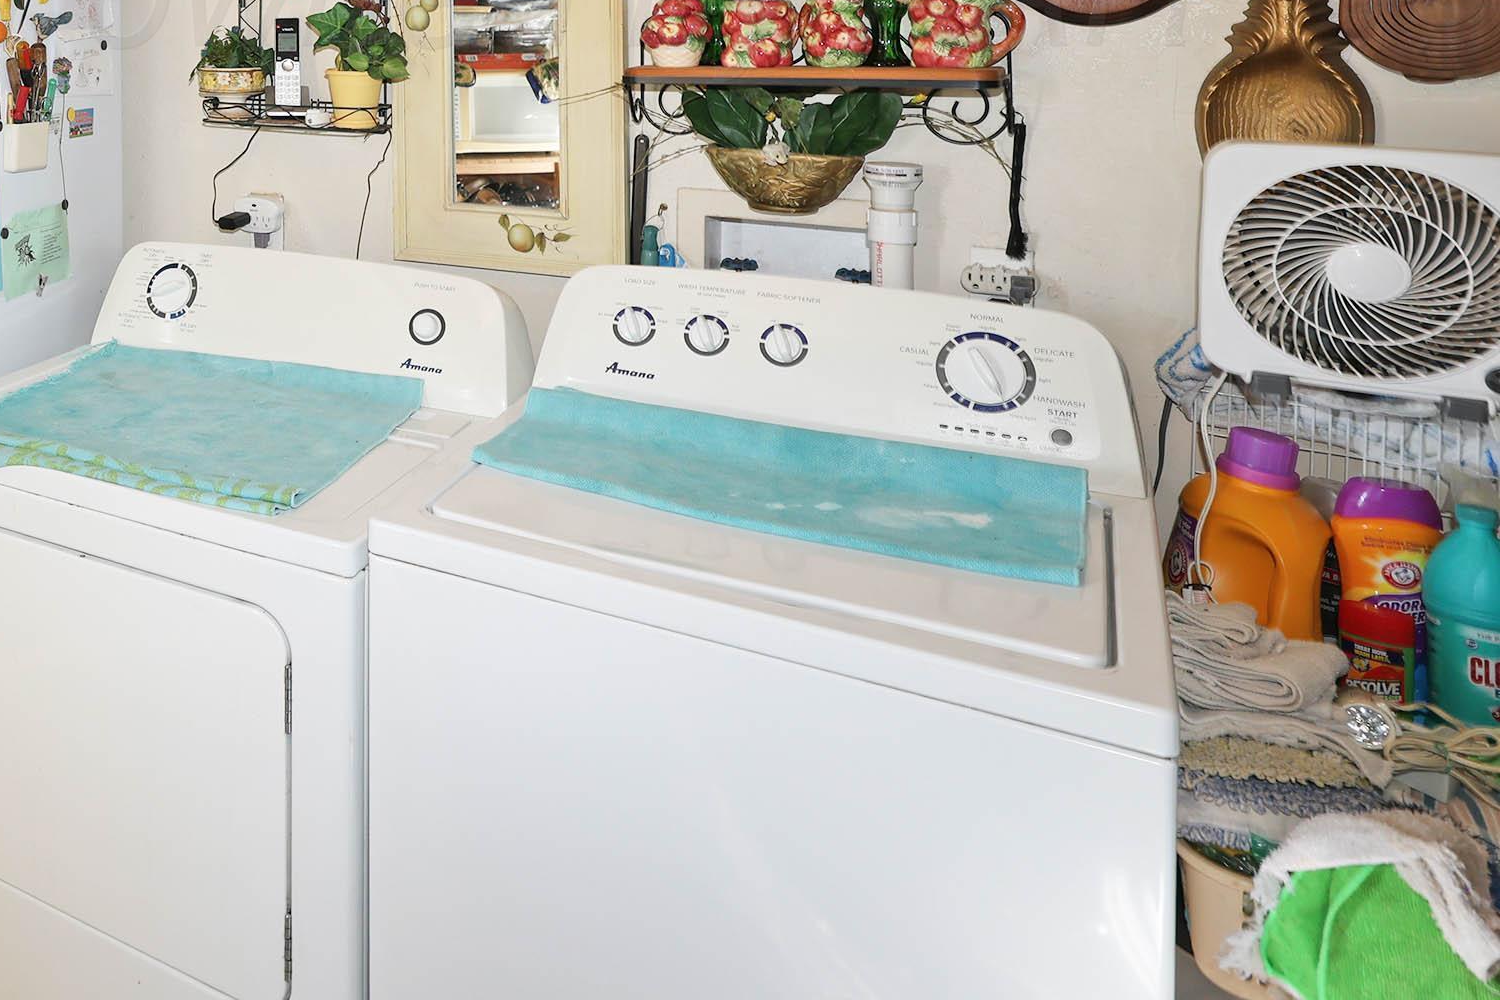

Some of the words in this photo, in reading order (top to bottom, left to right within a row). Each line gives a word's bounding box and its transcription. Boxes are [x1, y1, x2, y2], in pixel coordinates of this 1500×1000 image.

[624, 277, 642, 285] LOAD
[677, 283, 698, 291] WASH
[699, 285, 747, 296] TEMPERATURE
[756, 291, 782, 300] FABRIC
[783, 294, 821, 305] SOFTENER
[970, 313, 1004, 324] NORMAL
[900, 347, 929, 356] CASUAL
[1034, 347, 1075, 359] DELICATE
[400, 358, 442, 374] Amana
[605, 361, 655, 380] Amana
[1033, 395, 1086, 409] HANDWASH
[1047, 408, 1077, 419] START
